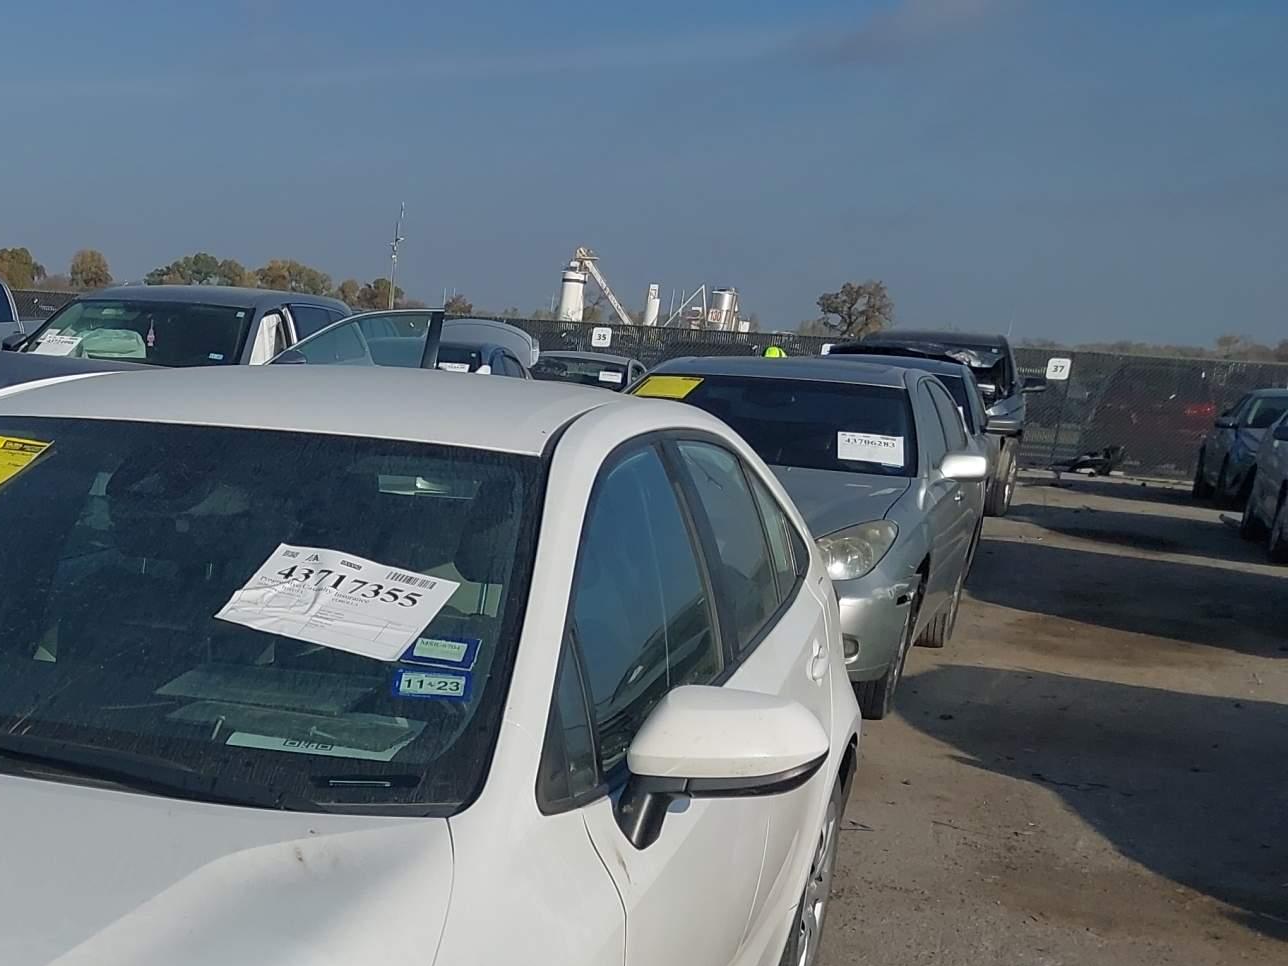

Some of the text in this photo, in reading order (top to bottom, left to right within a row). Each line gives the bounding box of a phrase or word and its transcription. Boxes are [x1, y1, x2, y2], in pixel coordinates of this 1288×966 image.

[597, 333, 607, 341] 35
[1052, 365, 1065, 373] 37
[277, 564, 423, 608] 43717355
